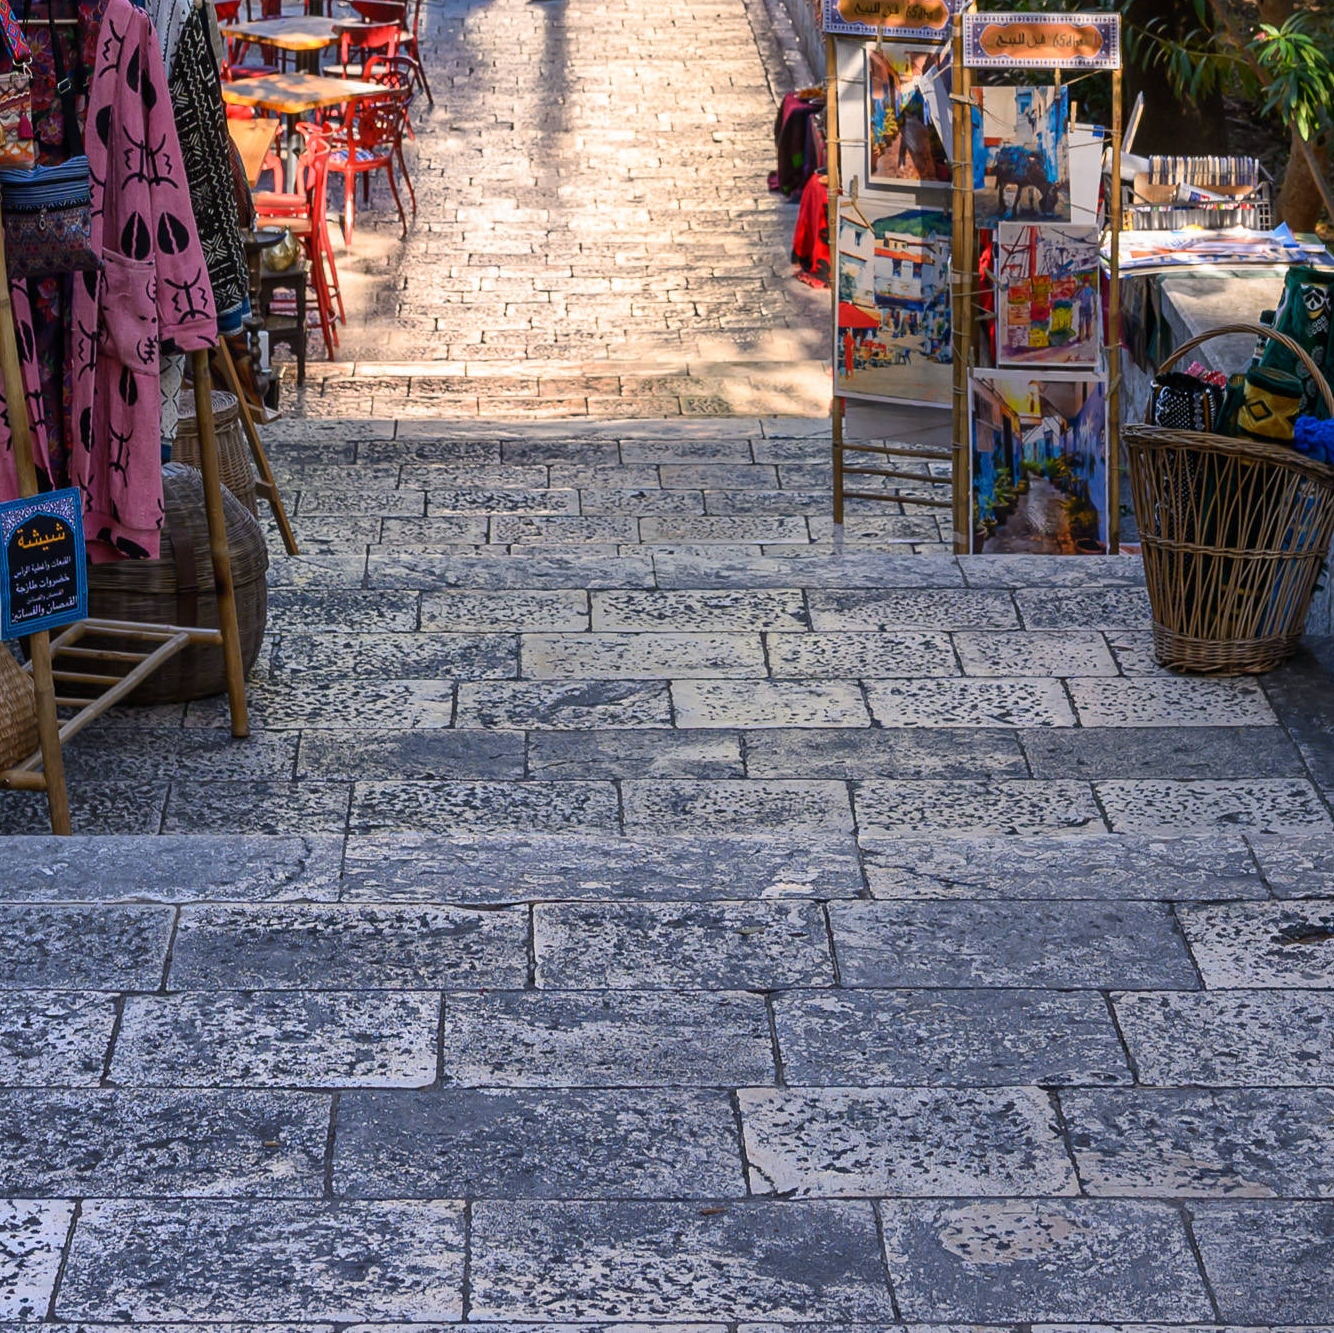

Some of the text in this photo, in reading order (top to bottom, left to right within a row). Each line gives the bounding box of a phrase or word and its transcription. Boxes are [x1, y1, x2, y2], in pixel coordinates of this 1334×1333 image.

[996, 32, 1025, 48] للبيع
[17, 522, 66, 551] شيشة
[45, 595, 78, 614] القمصان
